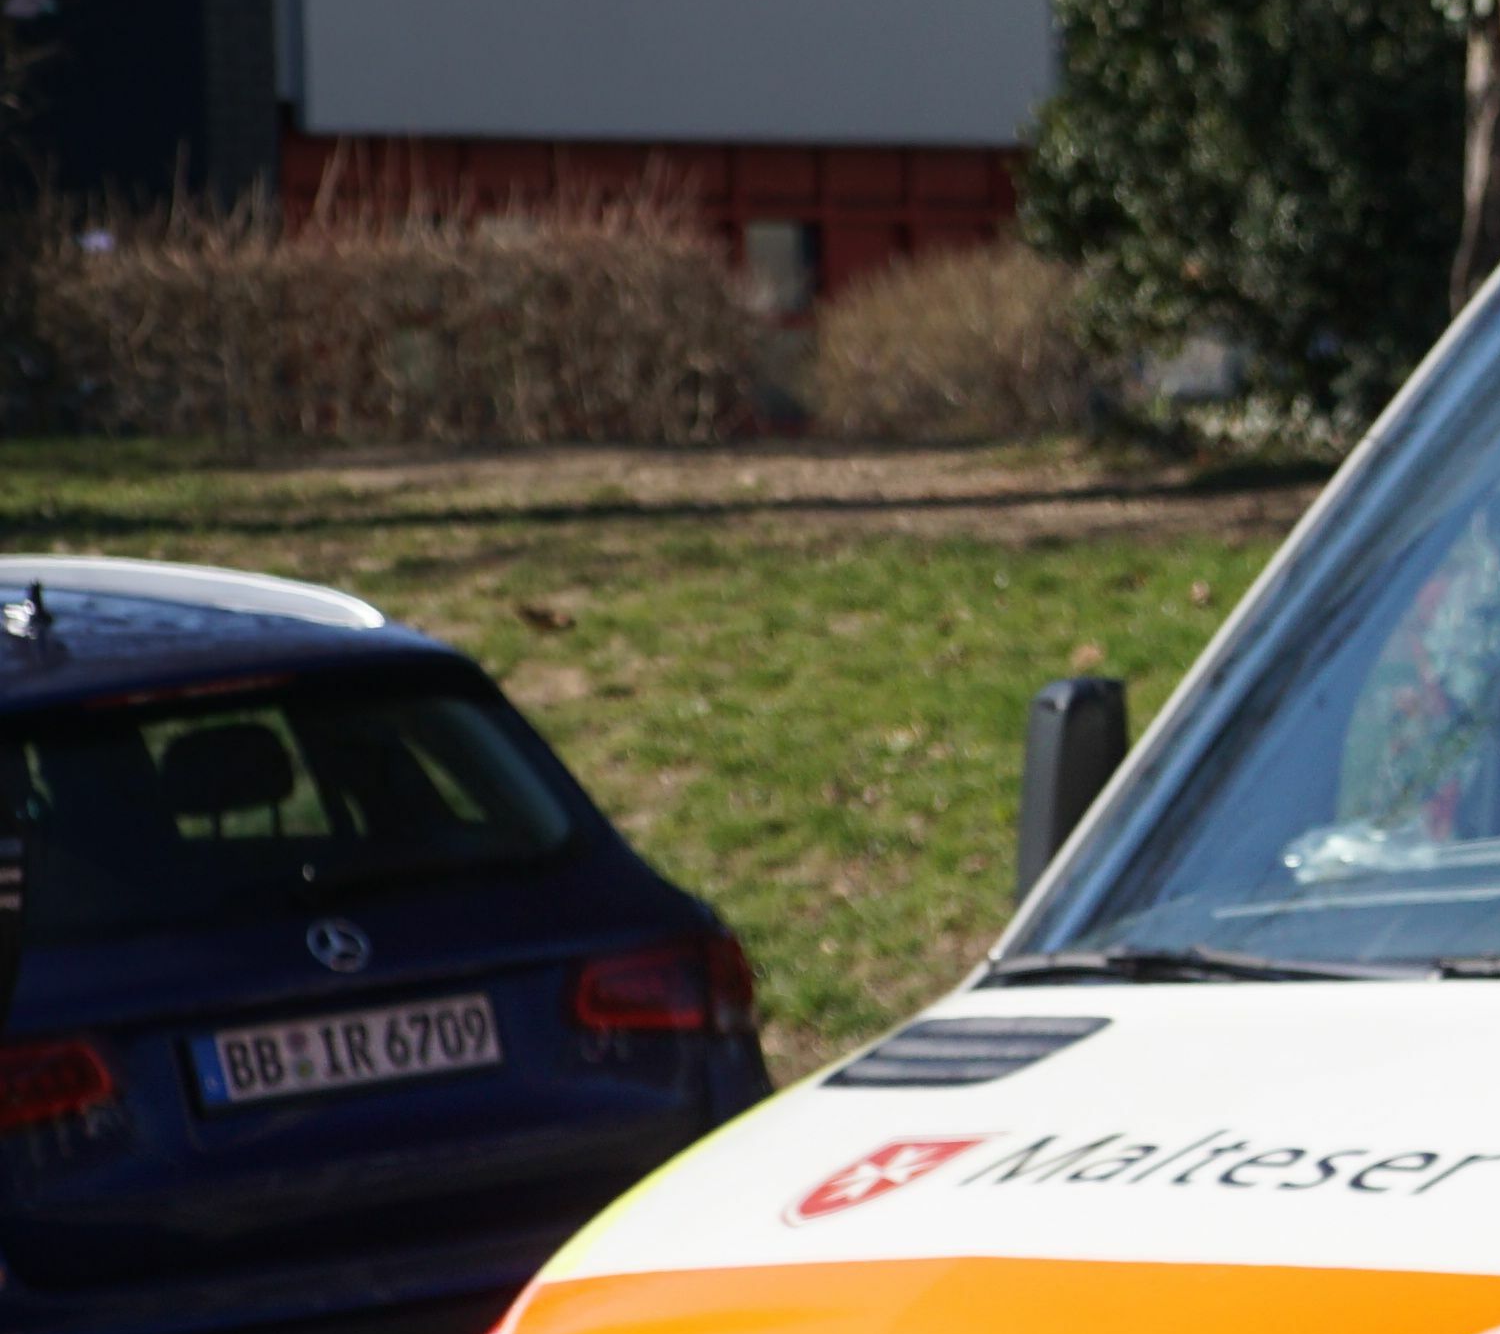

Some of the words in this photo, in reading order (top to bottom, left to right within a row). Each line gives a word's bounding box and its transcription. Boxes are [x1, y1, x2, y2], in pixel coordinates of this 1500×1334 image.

[227, 1037, 285, 1091] BB
[320, 1022, 376, 1078] IR
[386, 1007, 488, 1069] 6709
